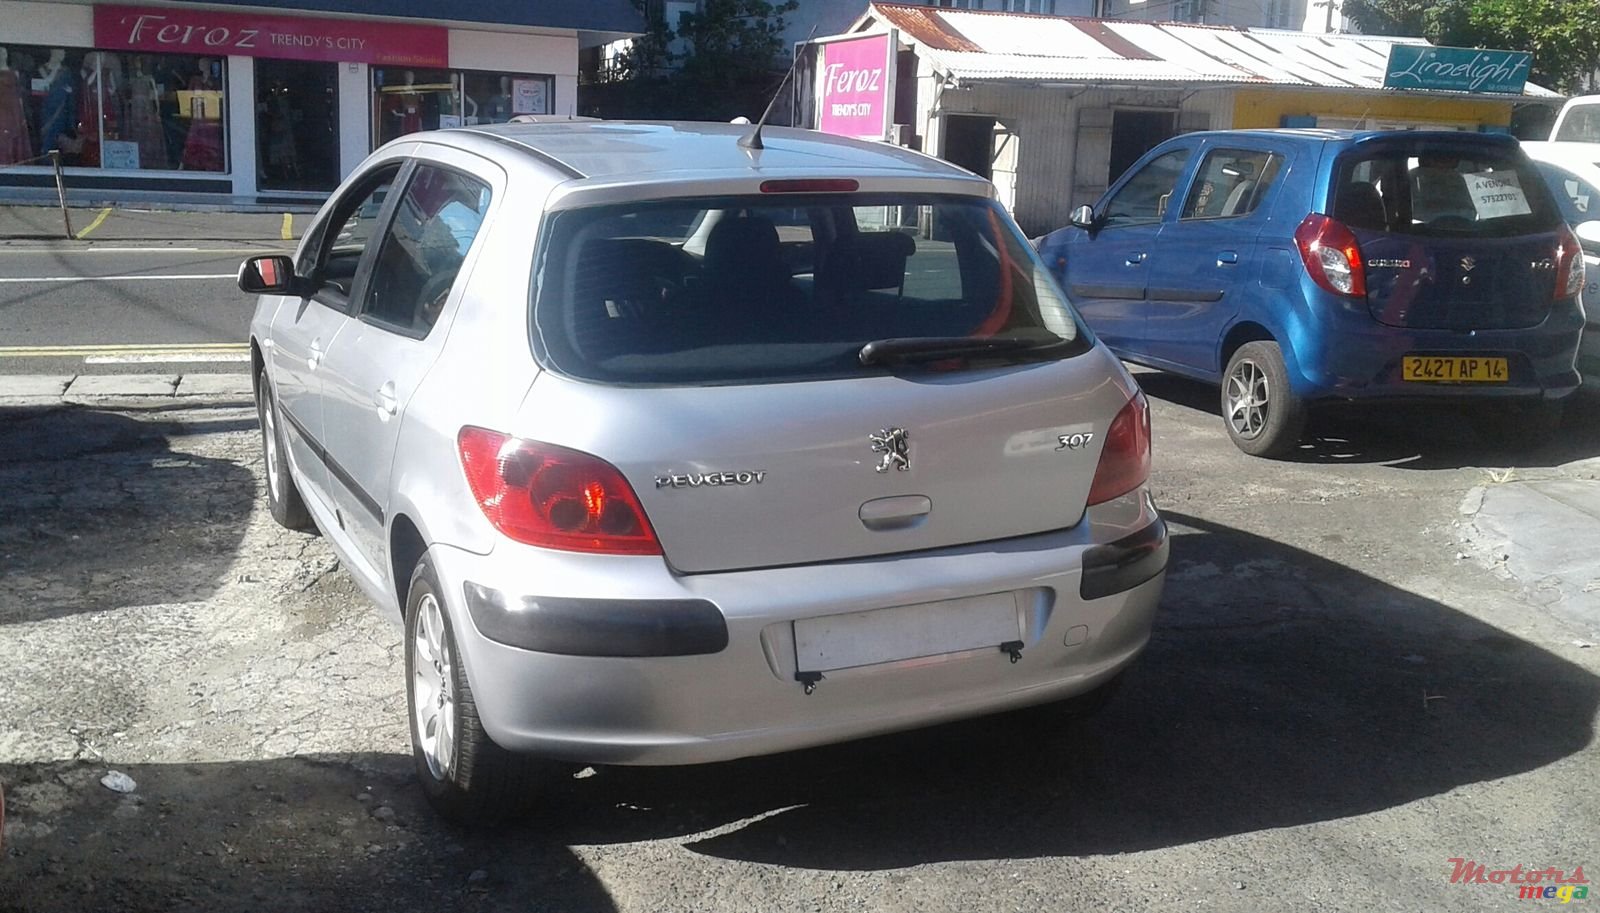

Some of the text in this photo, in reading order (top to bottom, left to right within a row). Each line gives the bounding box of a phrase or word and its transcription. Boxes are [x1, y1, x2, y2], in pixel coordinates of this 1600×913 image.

[120, 14, 259, 48] Feroz
[270, 33, 366, 50] TRENDY'S CITY
[824, 63, 882, 96] Feroz
[1390, 49, 1529, 90] Limelight
[1475, 182, 1482, 190] A
[1412, 358, 1502, 379] 2427 AP 14
[1055, 432, 1094, 451] 307
[655, 470, 767, 489] PEUGEOT
